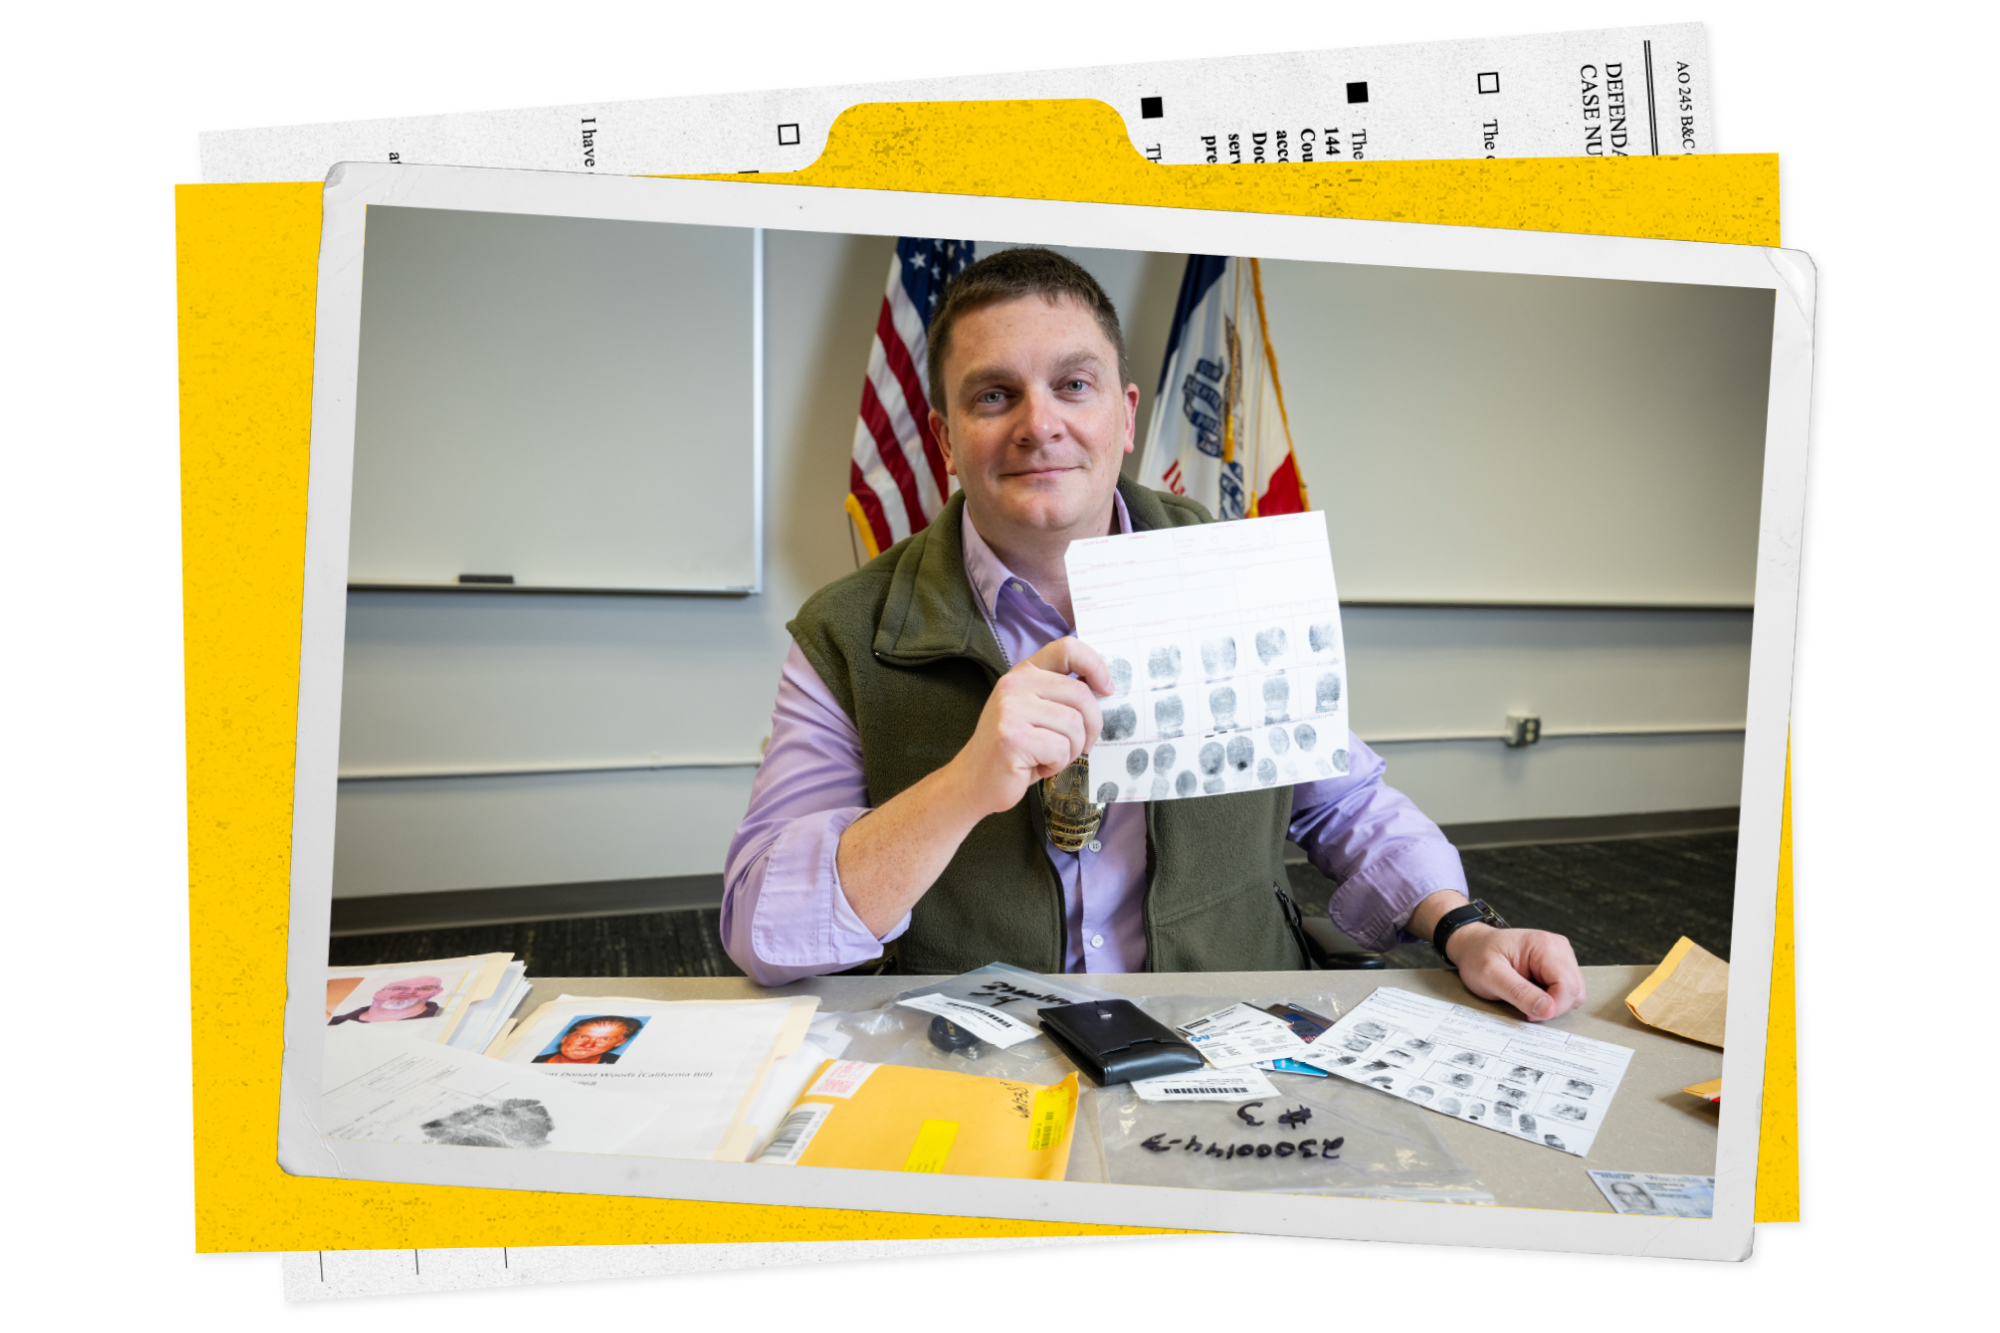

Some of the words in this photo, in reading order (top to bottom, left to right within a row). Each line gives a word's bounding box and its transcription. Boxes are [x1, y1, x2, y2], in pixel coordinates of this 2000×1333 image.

[1677, 61, 1690, 84] AO
[1580, 65, 1600, 120] CASE
[1679, 87, 1692, 111] 245
[582, 129, 597, 167] have
[1252, 131, 1267, 163] Doc
[1300, 128, 1316, 163] Cou
[1324, 127, 1341, 156] 144
[1352, 129, 1367, 160] The
[1483, 119, 1499, 150] The
[1585, 125, 1603, 156] NU
[1681, 116, 1696, 149] B&C
[1201, 135, 1218, 164] pre
[638, 1071, 691, 1079] (California
[693, 1071, 713, 1079] Bill)
